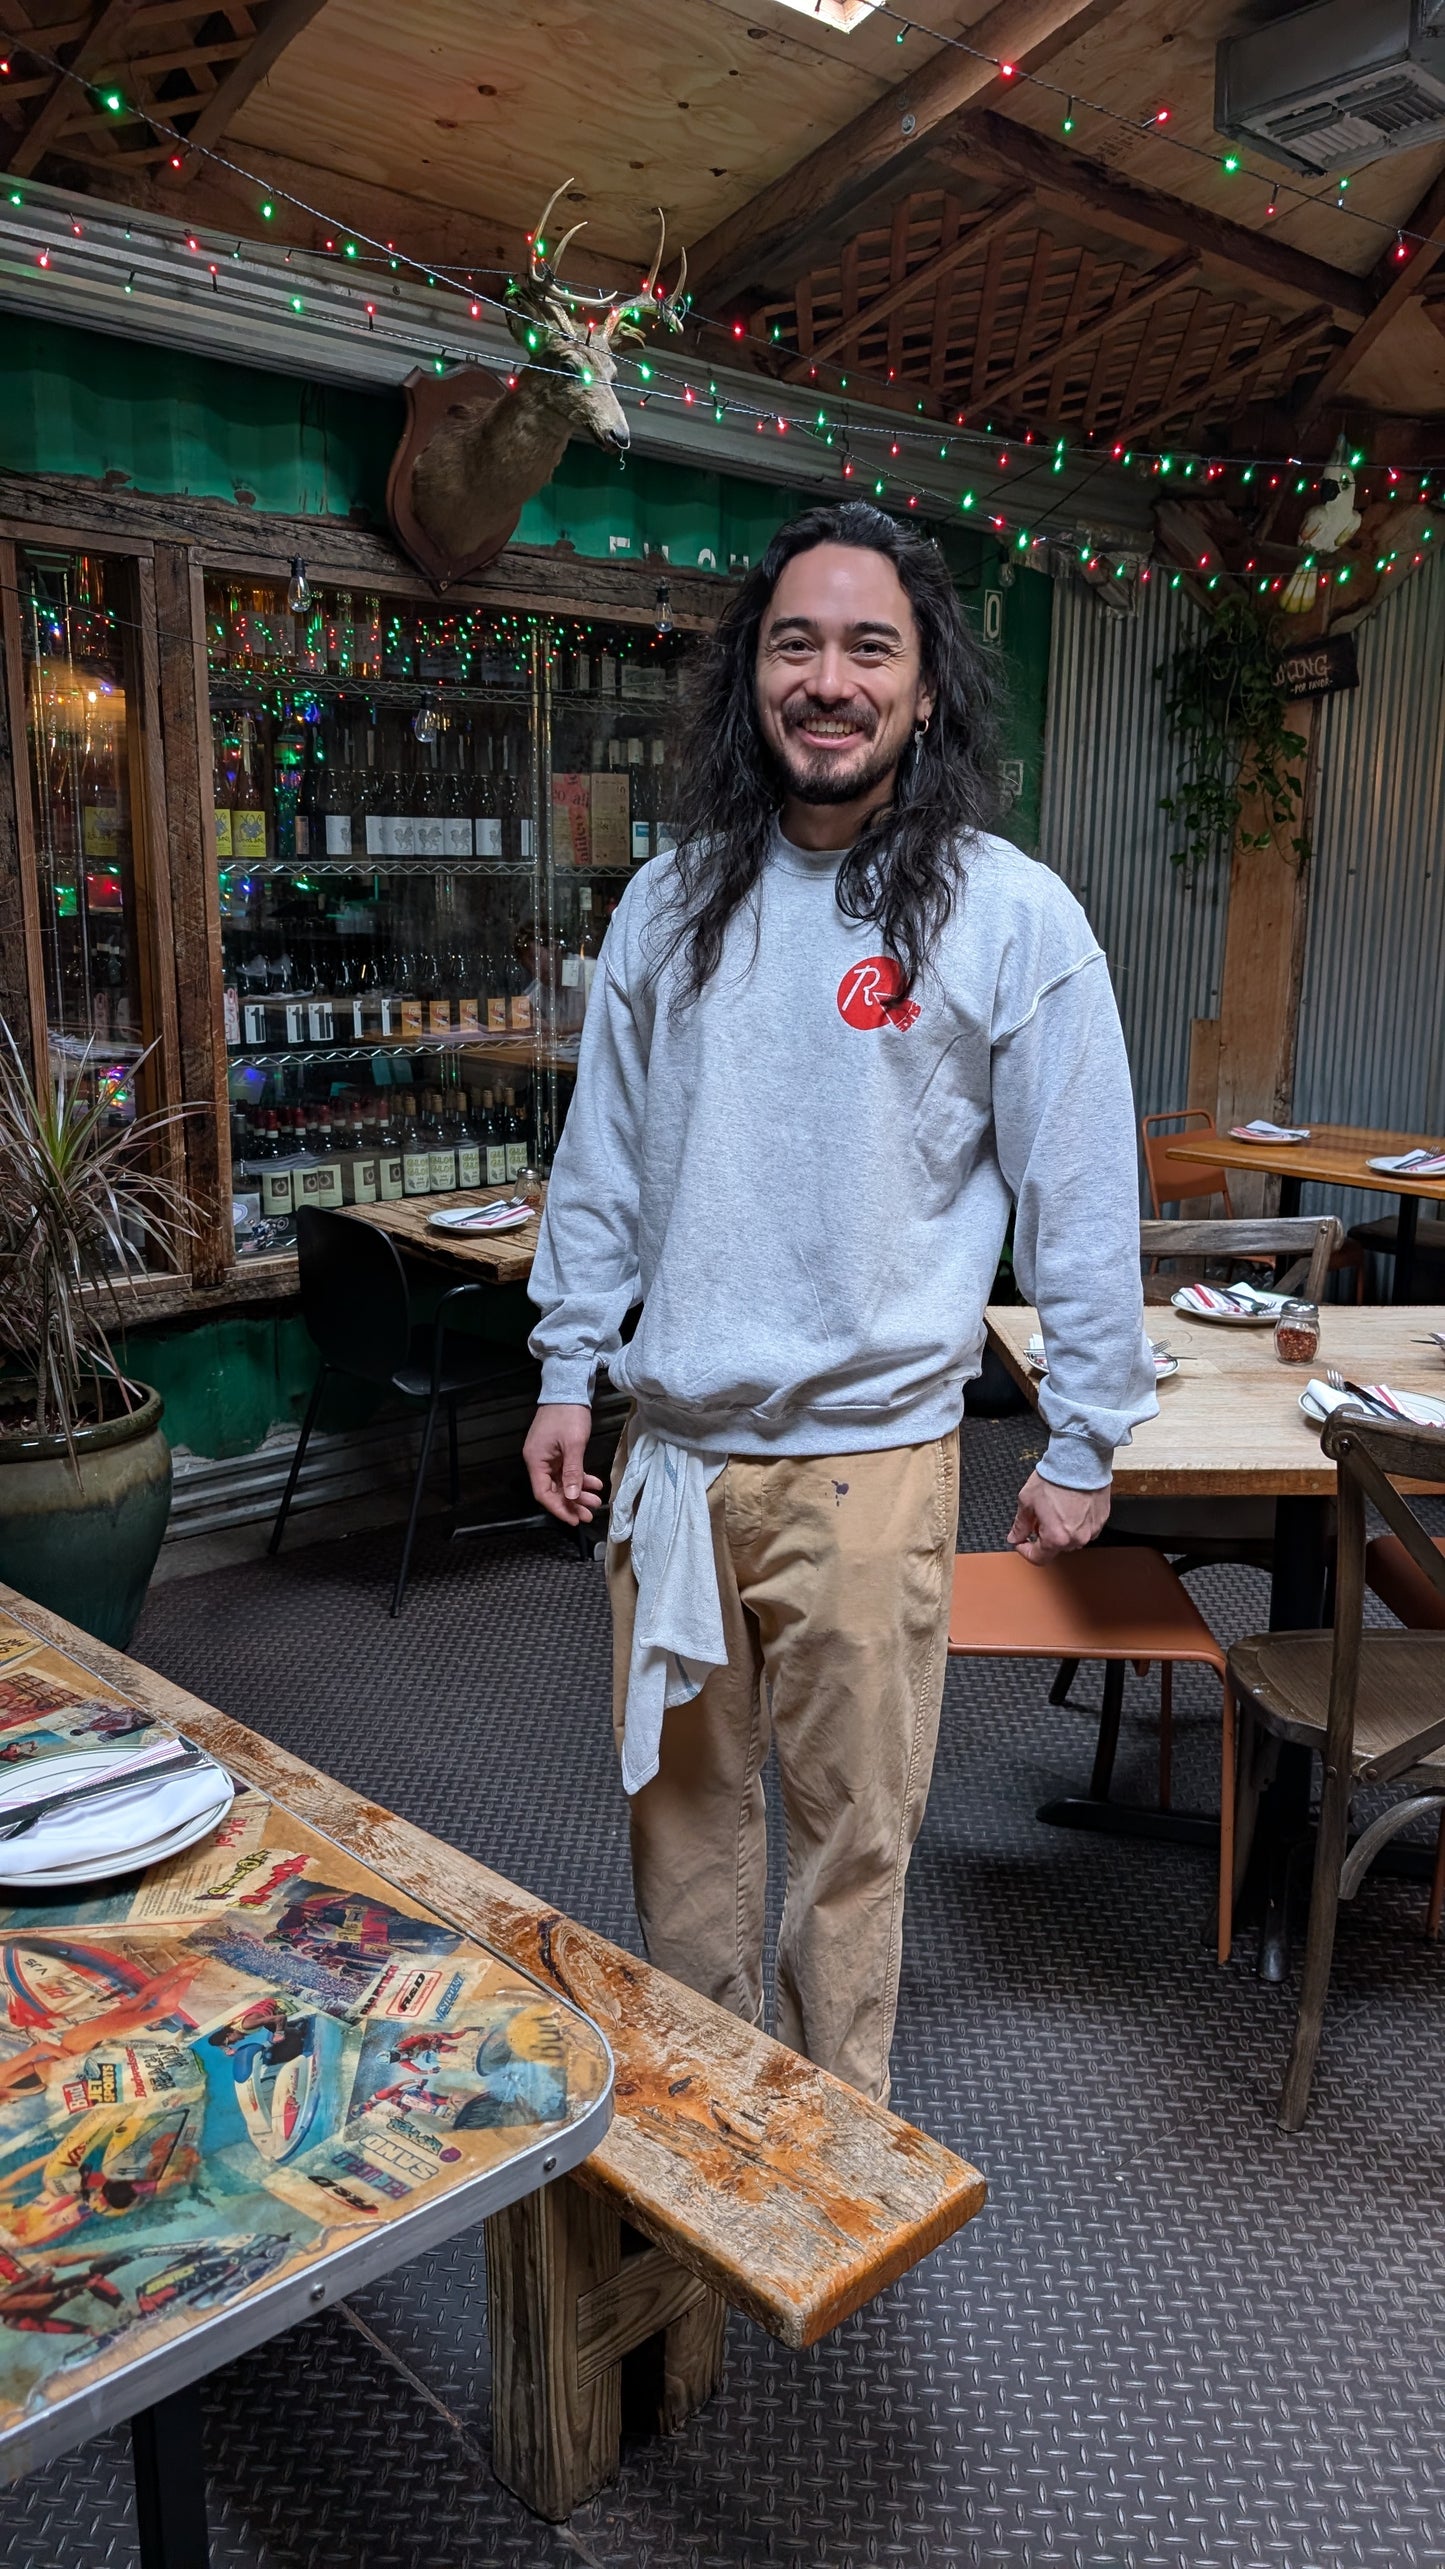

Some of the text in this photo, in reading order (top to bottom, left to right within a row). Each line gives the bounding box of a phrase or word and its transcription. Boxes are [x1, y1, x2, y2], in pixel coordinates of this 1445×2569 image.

[841, 964, 881, 1012] R
[87, 2079, 103, 2103] JET
[102, 2064, 116, 2103] SPORTS
[125, 2046, 148, 2099] Budweiser
[70, 2083, 89, 2111] Bud
[358, 2132, 440, 2181] SANO
